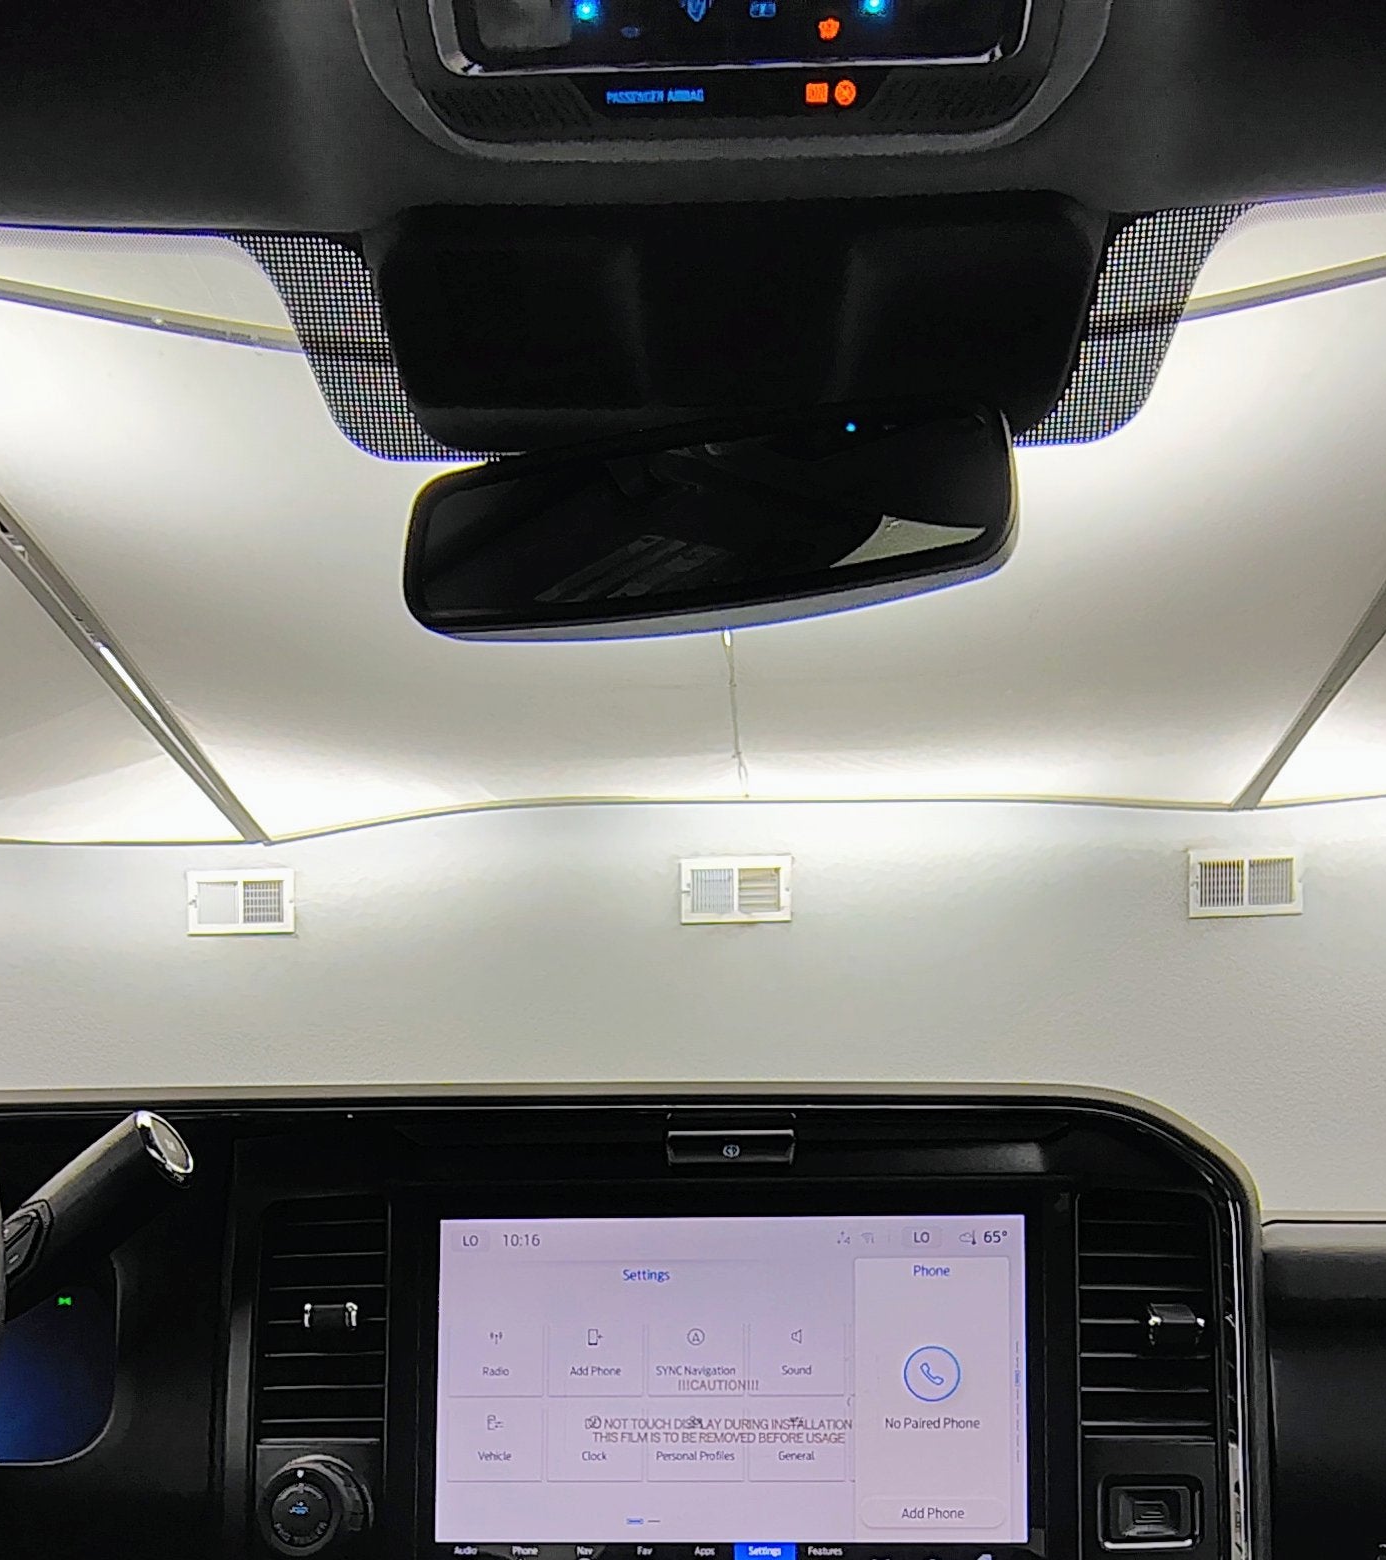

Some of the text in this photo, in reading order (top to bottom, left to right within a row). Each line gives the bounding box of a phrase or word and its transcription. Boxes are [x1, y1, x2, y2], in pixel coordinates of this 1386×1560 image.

[463, 1234, 541, 1247] LO 10:16
[913, 1232, 930, 1244] LO
[622, 1269, 671, 1282] Settings
[913, 1265, 951, 1277] Phone
[482, 1366, 510, 1377] Radio
[569, 1365, 622, 1377] Add Phone
[655, 1364, 736, 1378] SYNC Navigation
[781, 1365, 812, 1376] Sound
[604, 1418, 629, 1430] NOT
[632, 1418, 671, 1430] TOUCH
[674, 1417, 722, 1430] DISPLAY
[724, 1418, 769, 1430] DURING
[771, 1417, 853, 1430] INSTALLATION
[885, 1417, 981, 1429] No Paired Phone
[593, 1432, 846, 1444] THIS FILM IS TO BE REMOVED BEFORE USAGE
[478, 1451, 512, 1461] Vehicle
[581, 1450, 607, 1461] Clock
[656, 1450, 735, 1461] Personal Profiles
[778, 1450, 815, 1461] General
[901, 1507, 965, 1519] Add Phone
[453, 1546, 478, 1555] Audio
[512, 1545, 539, 1556] Phone
[576, 1546, 594, 1556] Nav
[694, 1545, 716, 1557] Apps
[748, 1545, 782, 1558] Settings
[808, 1545, 843, 1557] Features
